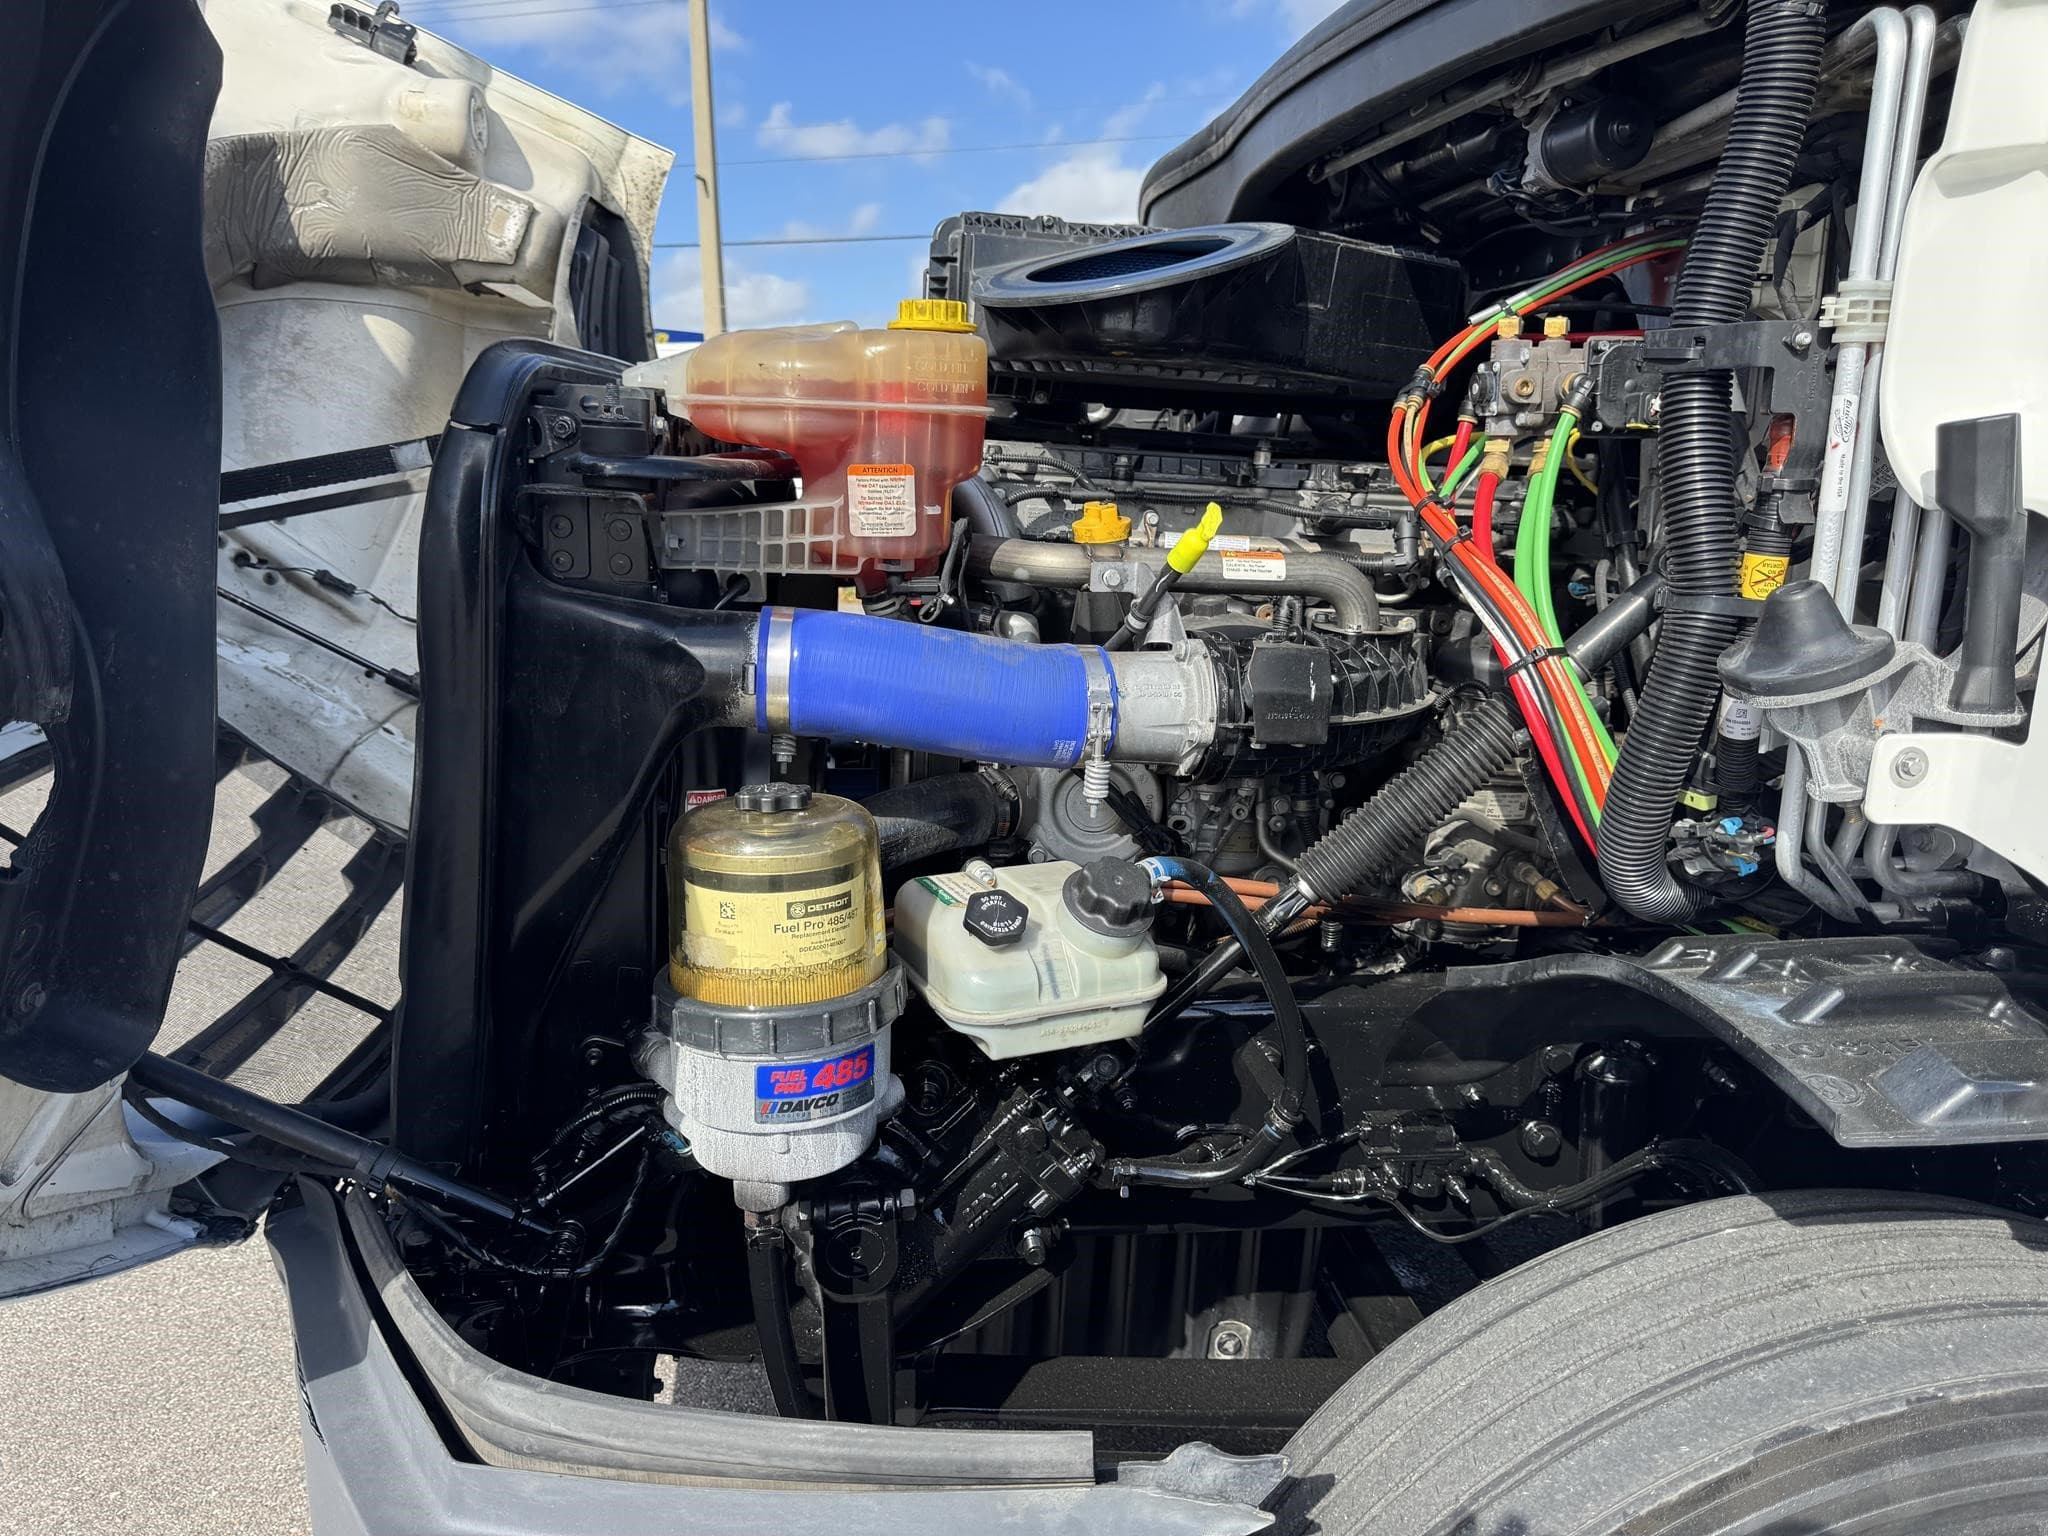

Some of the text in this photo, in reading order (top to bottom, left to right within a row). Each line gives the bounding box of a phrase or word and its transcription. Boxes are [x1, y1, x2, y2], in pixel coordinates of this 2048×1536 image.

[697, 794, 725, 804] DANGER
[807, 897, 849, 912] DETROIT
[981, 900, 1007, 910] OVERFILL
[774, 922, 800, 934] Fuel
[804, 921, 824, 931] Pro
[980, 915, 1023, 932] POWER STEERING
[993, 919, 1012, 927] FLUID
[791, 929, 831, 939] Replacement
[770, 1052, 868, 1090] FUEL 485
[774, 1080, 806, 1094] PRO
[777, 1093, 840, 1113] DAVCO
